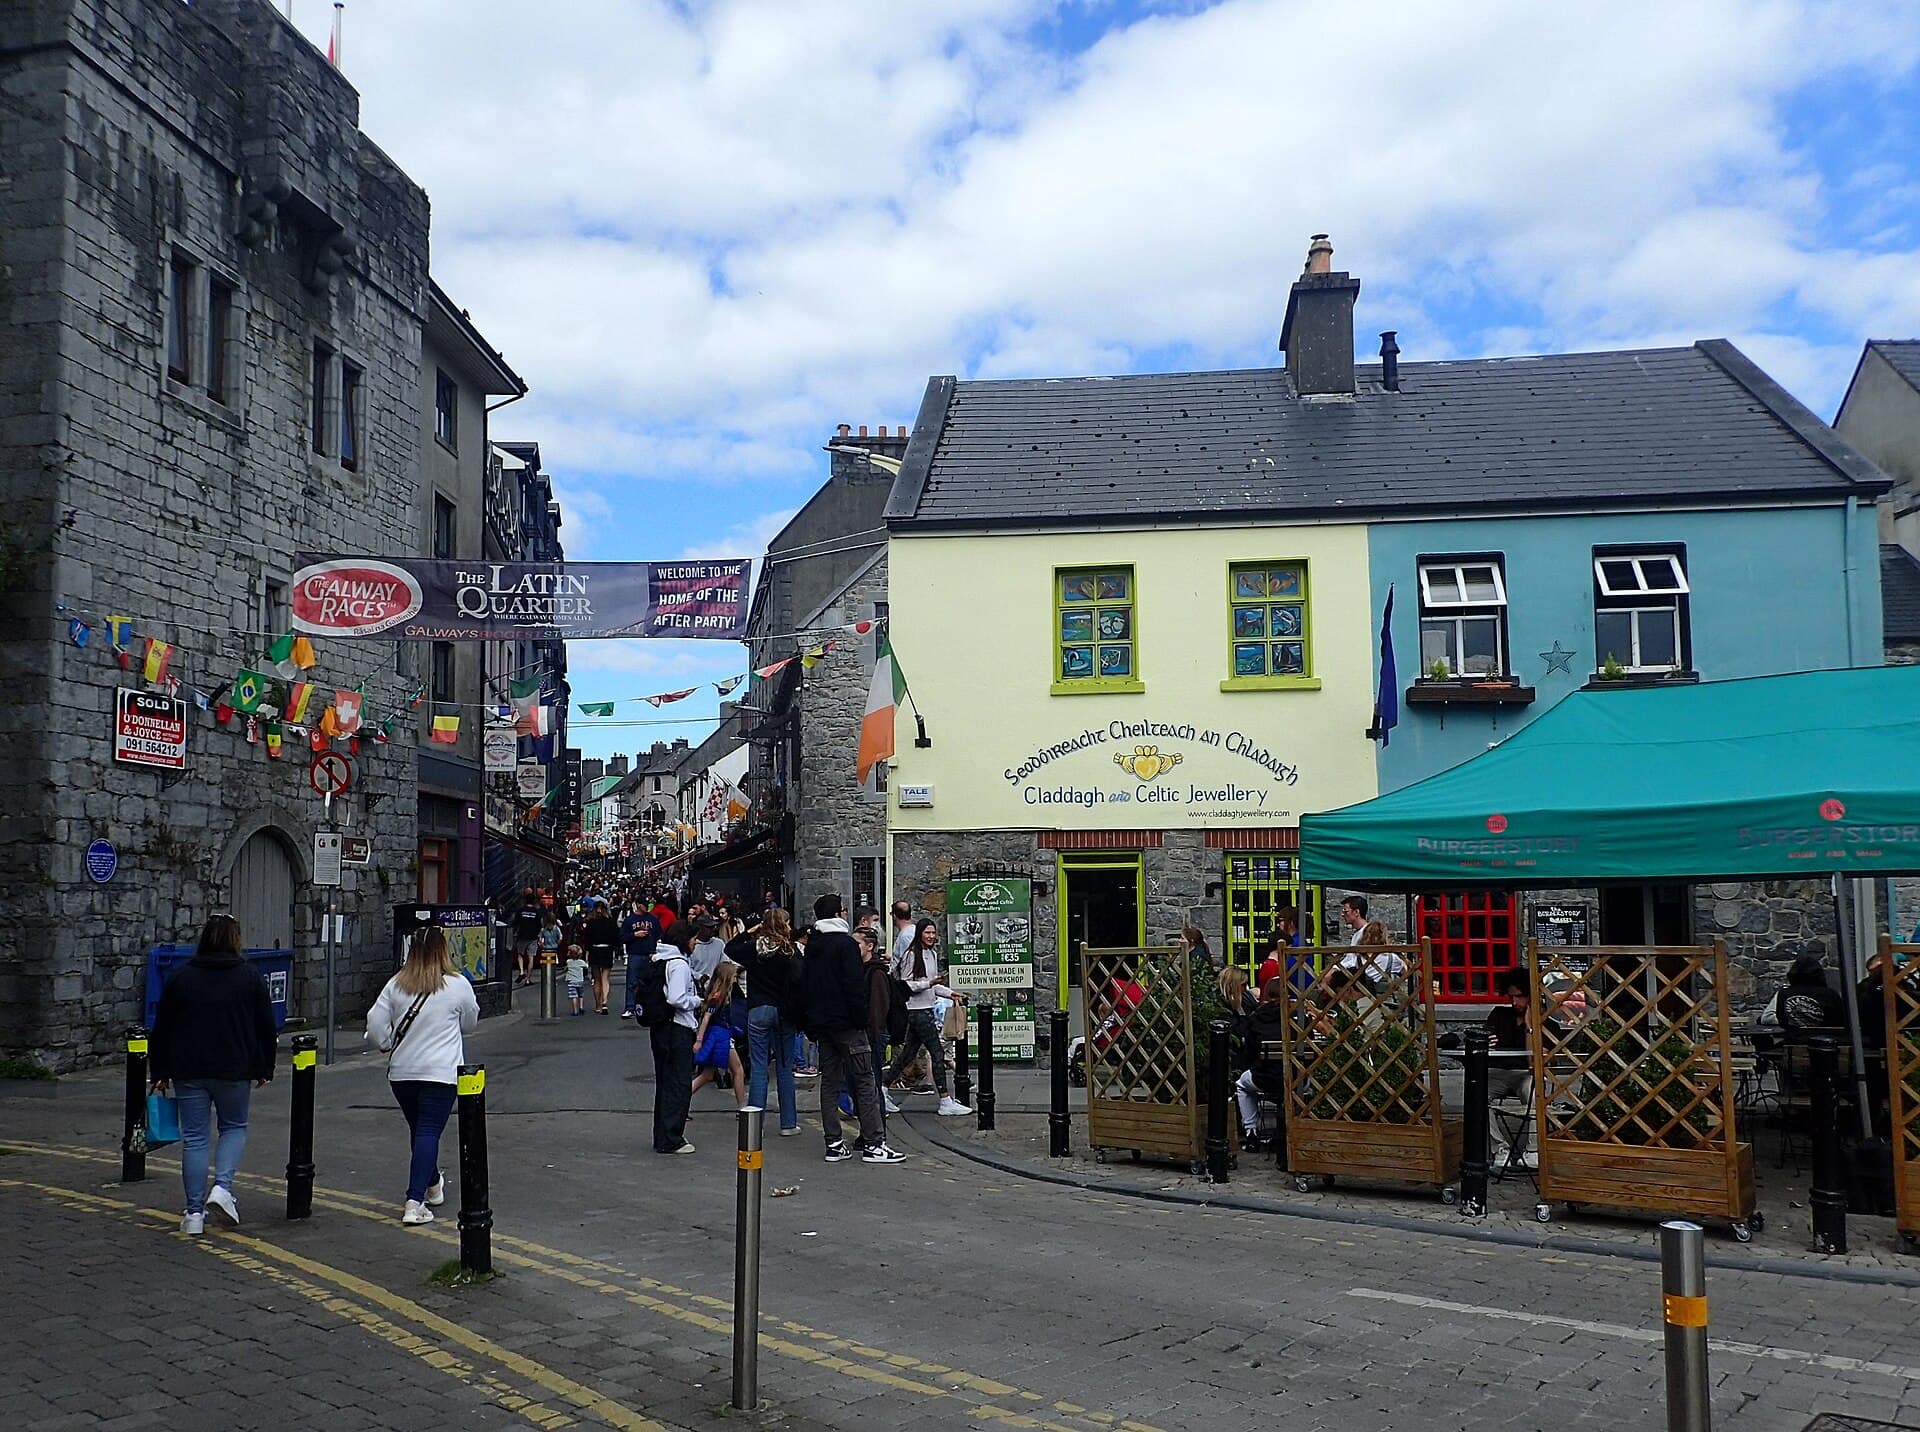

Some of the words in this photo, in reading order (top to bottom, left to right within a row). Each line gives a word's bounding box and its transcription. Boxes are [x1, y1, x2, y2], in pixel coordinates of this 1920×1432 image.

[455, 571, 486, 584] THE
[488, 565, 590, 594] LATIN
[657, 567, 706, 579] WELCOME
[708, 566, 720, 577] TO
[723, 565, 741, 575] THE
[304, 575, 398, 601] GALWAY
[659, 591, 694, 606] HOME
[696, 587, 713, 601] OF
[716, 588, 739, 603] THE
[319, 597, 388, 623] RACES
[456, 586, 595, 618] QUARTER
[404, 624, 479, 638] GALWAY'S
[653, 613, 690, 628] AFTER
[694, 615, 736, 630] PARTY!
[136, 697, 170, 711] SOLD
[123, 713, 181, 733] O'DONNELLAN
[123, 724, 132, 735] &
[133, 726, 162, 740] JOYCE
[126, 738, 142, 751] 091
[145, 741, 178, 757] 564212
[1004, 729, 1108, 786] Seodóireacht
[1109, 719, 1196, 742] Cheilteach
[1199, 730, 1221, 747] an
[1225, 731, 1299, 787] Chladaigh
[569, 771, 577, 816] HOTEL
[1024, 785, 1105, 808] Claddagh
[1108, 790, 1132, 803] and
[1136, 784, 1180, 802] Celtic
[1185, 783, 1268, 807] Jewellery
[1187, 809, 1290, 820] www.claddaghjewellery.com
[1416, 836, 1582, 856] BURGERSTORY
[1737, 825, 1920, 849] BURGERSTOR
[1004, 953, 1020, 962] €35
[957, 968, 990, 976] EXCLUSIVE
[958, 977, 973, 985] OUR
[973, 976, 988, 984] OWN
[989, 976, 1024, 984] WORKSHOP
